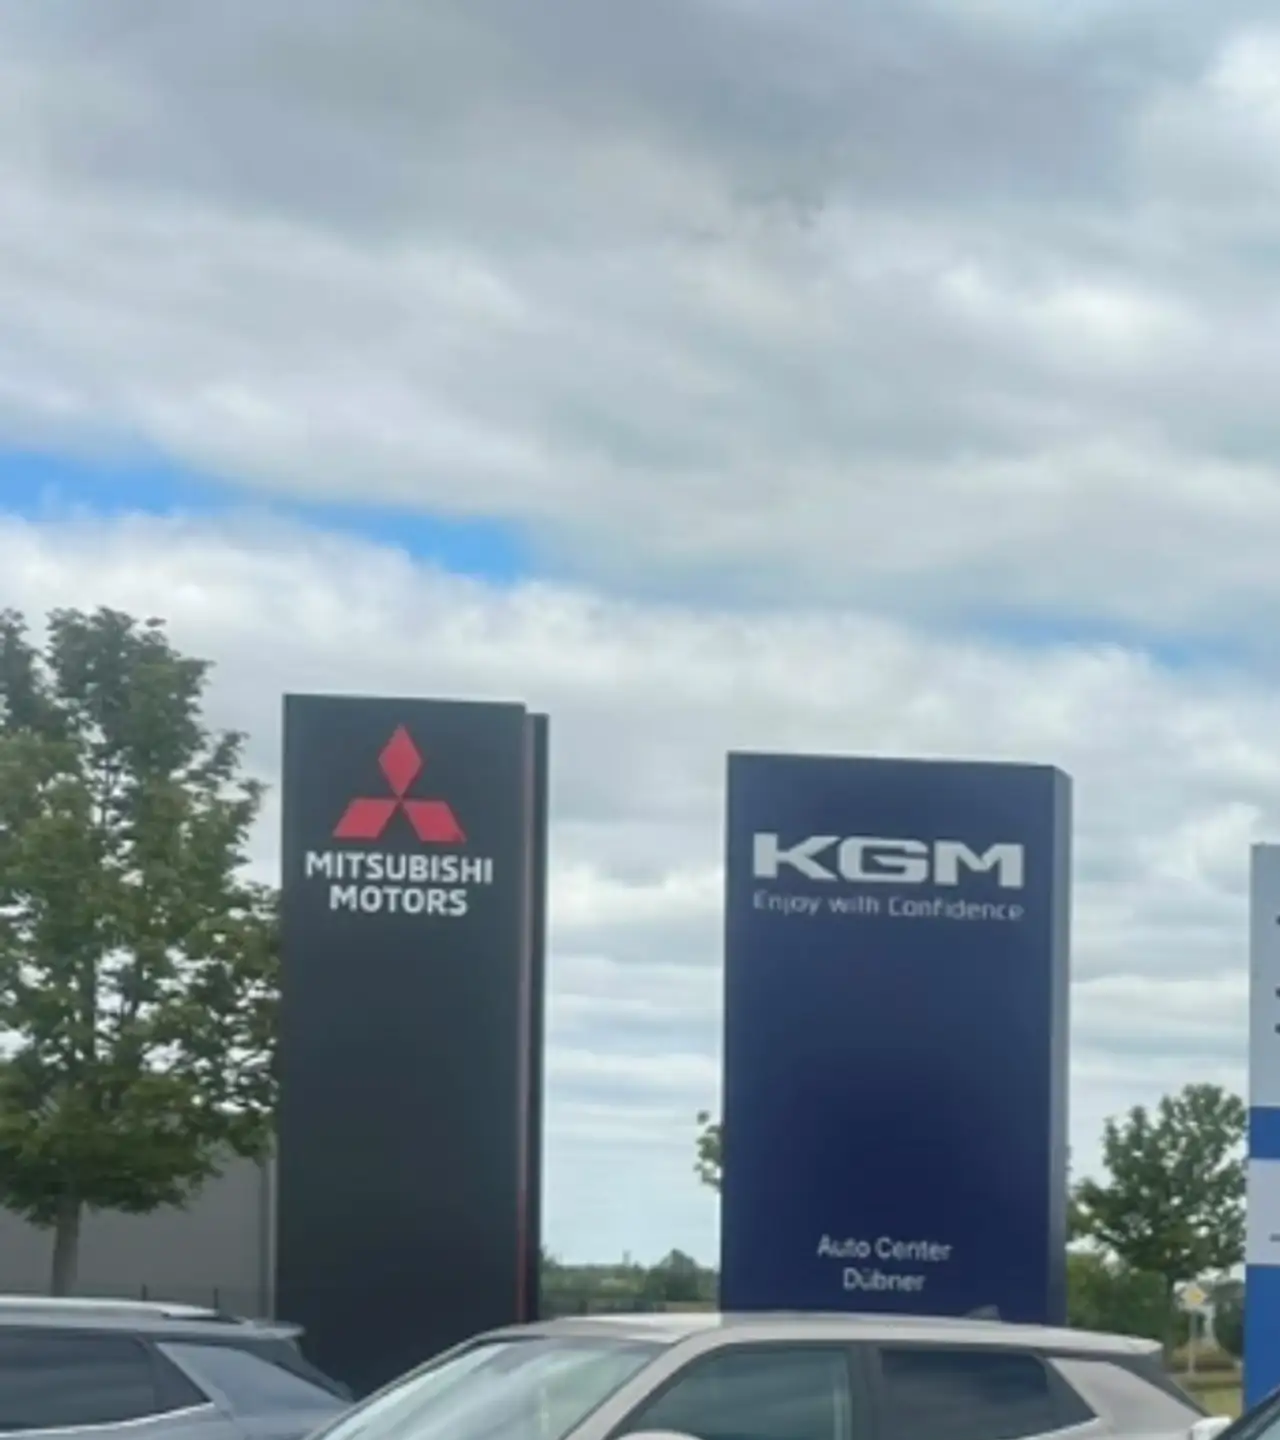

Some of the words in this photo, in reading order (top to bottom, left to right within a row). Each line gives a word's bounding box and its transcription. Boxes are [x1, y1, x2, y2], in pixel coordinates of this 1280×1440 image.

[305, 851, 494, 884] MITSUBISHI
[753, 832, 1025, 889] KGM
[329, 885, 468, 916] MOTORS
[753, 890, 821, 915] Enjoy
[829, 895, 880, 915] with
[888, 895, 1024, 921] Confidence
[817, 1234, 872, 1259] Auto
[875, 1236, 952, 1262] Center
[843, 1266, 927, 1291] Dübner
